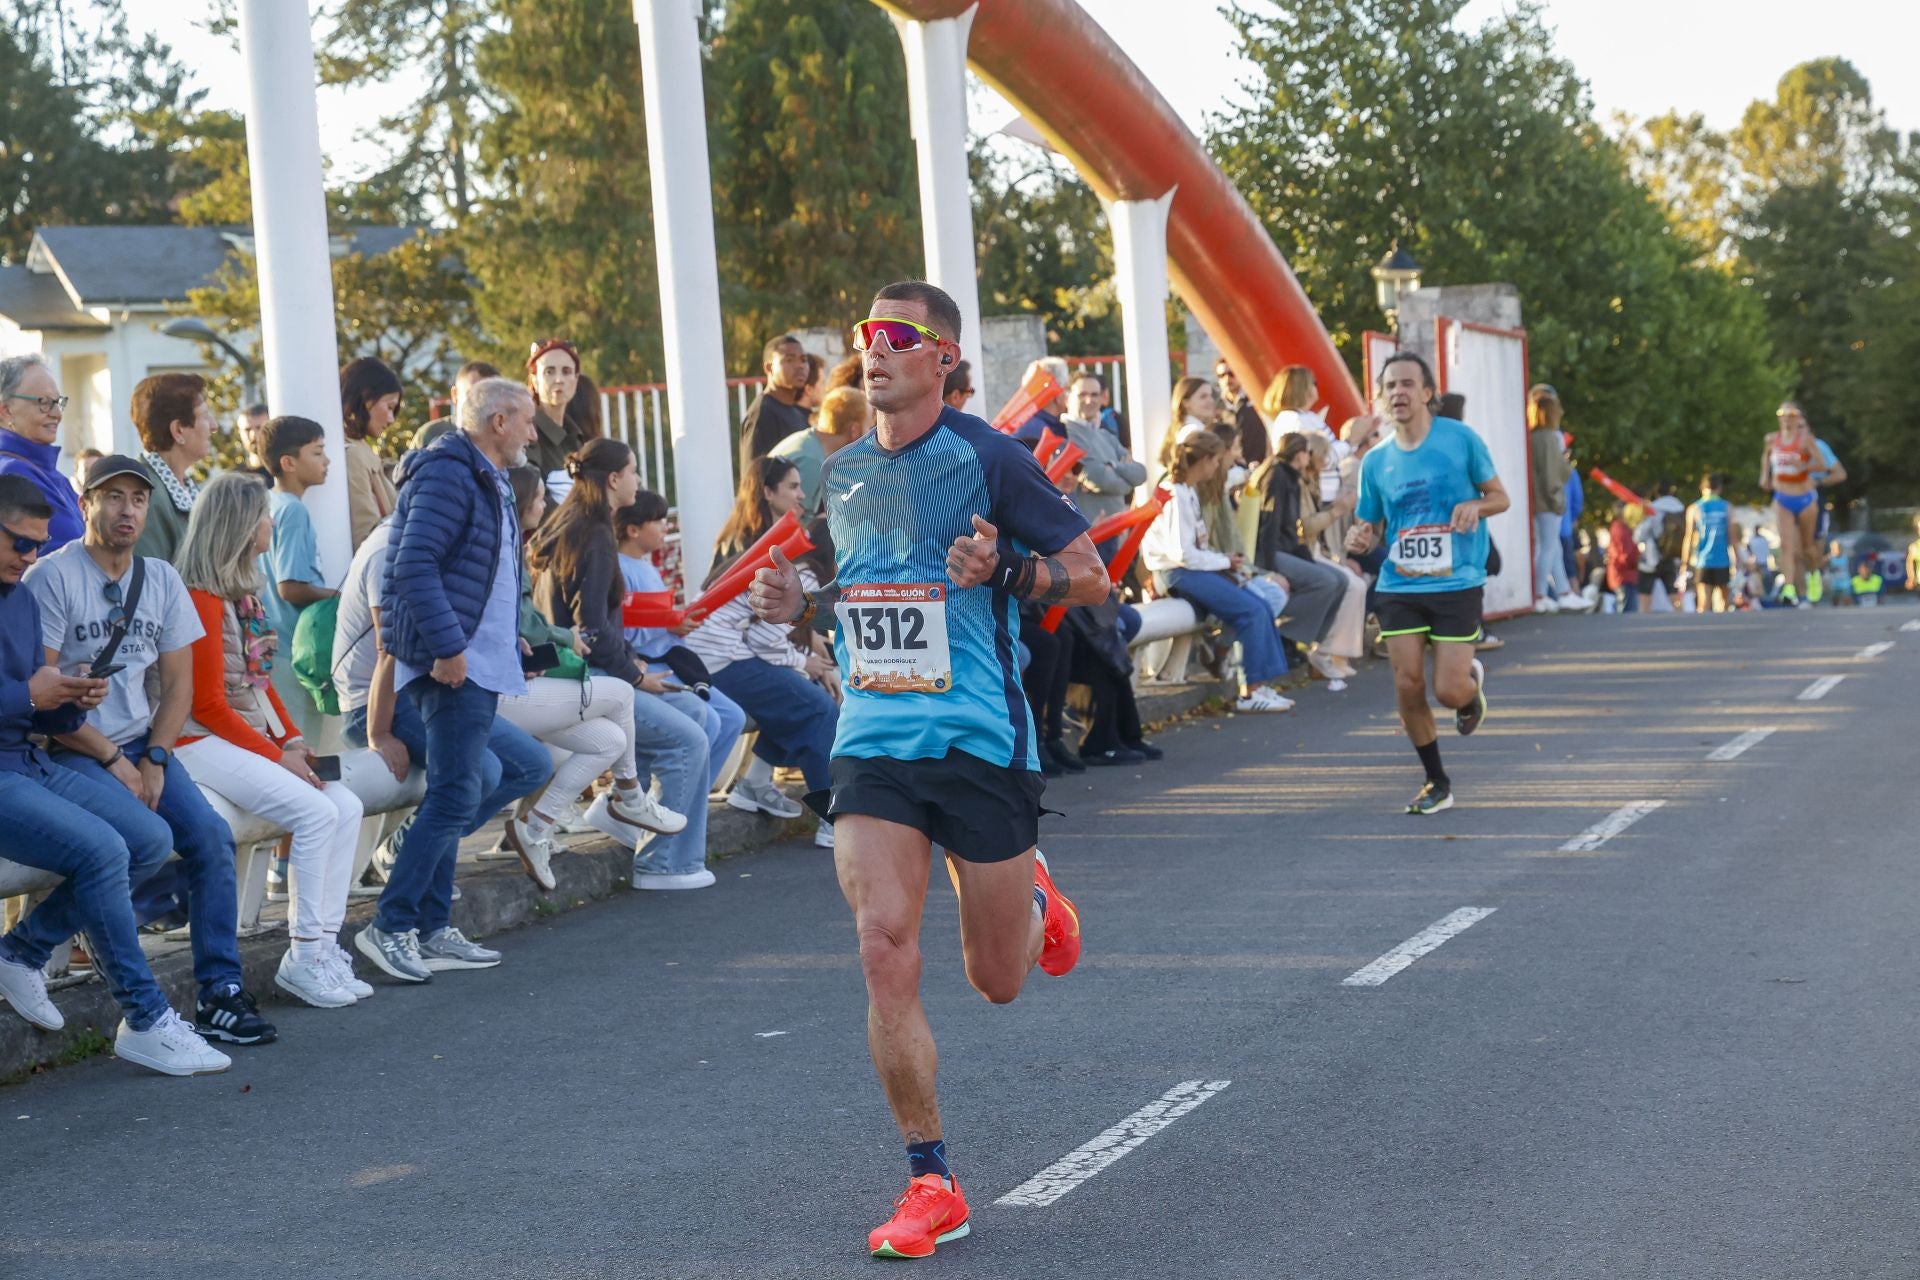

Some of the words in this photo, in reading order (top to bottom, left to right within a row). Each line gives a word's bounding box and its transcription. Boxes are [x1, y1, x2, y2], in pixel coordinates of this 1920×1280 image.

[1399, 537, 1442, 558] 1503
[861, 589, 882, 597] MBA
[900, 588, 924, 597] GIJÓN
[75, 619, 163, 642] CONRS
[848, 607, 928, 650] 1312
[121, 643, 145, 654] STAR
